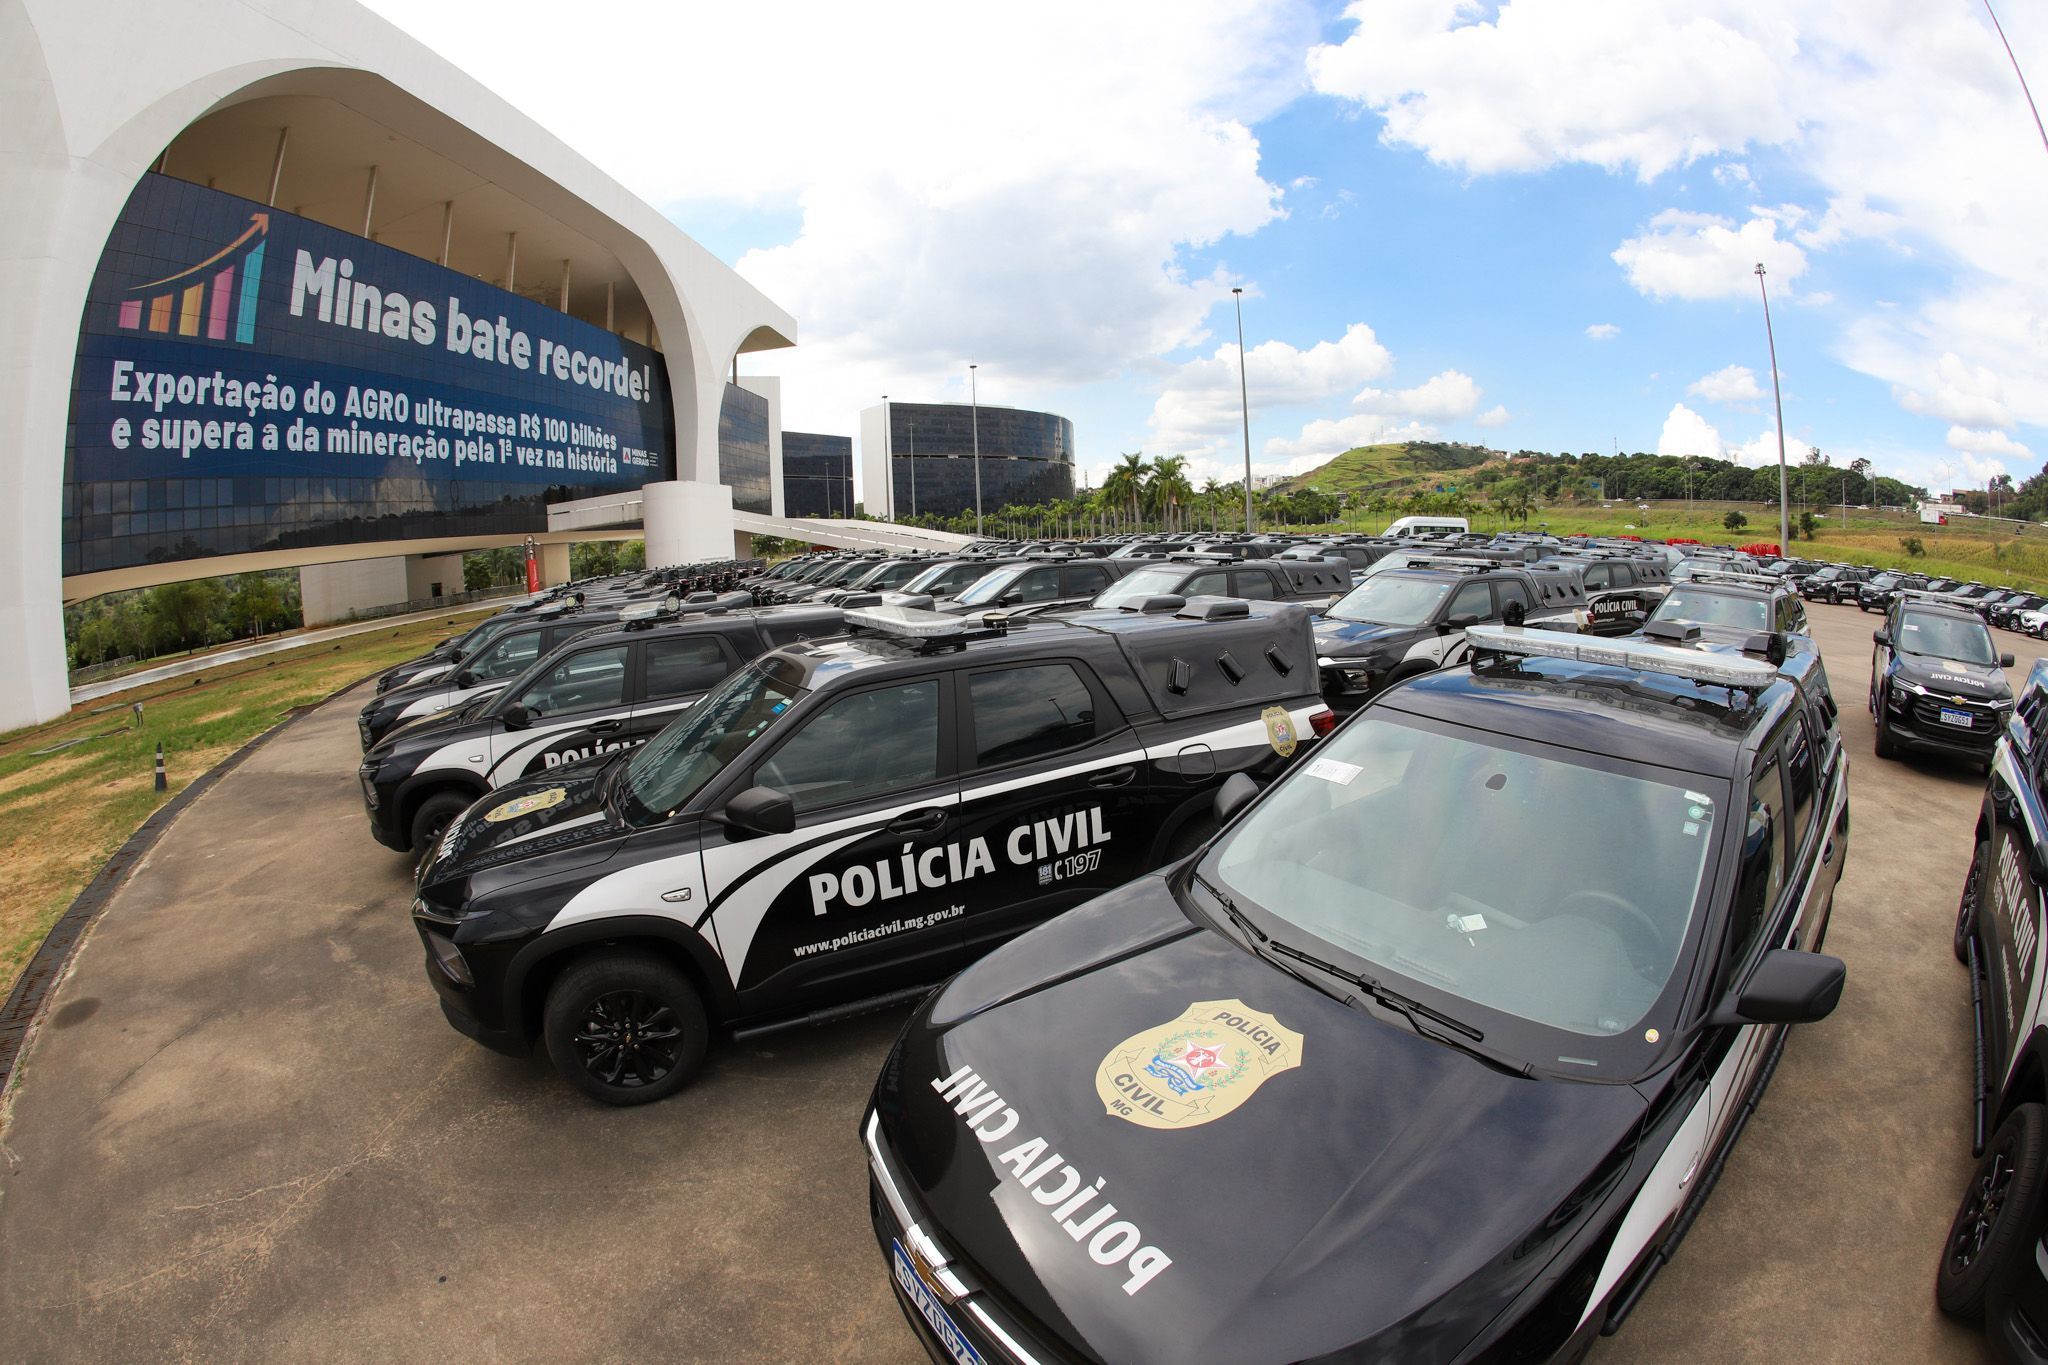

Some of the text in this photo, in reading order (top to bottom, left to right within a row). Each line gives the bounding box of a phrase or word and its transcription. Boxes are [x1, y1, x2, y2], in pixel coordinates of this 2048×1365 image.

[290, 248, 651, 404] Minas bate recorde!
[111, 360, 618, 451] Exportação do AGRO ultrapassa R$ 100 bilhões
[111, 418, 132, 450] e
[141, 417, 254, 459] supera
[262, 423, 279, 451] a
[286, 417, 320, 452] da
[327, 420, 450, 466] mineração
[455, 435, 495, 467] pela
[499, 438, 513, 464] 1ª
[516, 446, 544, 468] vez
[547, 449, 565, 469] na
[567, 446, 618, 475] história
[631, 448, 648, 458] MINAS
[631, 457, 650, 467] GERAIS
[1594, 600, 1638, 614] POLÍCIA CIVIL
[808, 806, 1112, 917] POLÍCIA CIVIL
[1064, 849, 1102, 878] 197
[793, 903, 966, 958] www.policiacivil.mg.gov.br
[1212, 1011, 1282, 1056] POLÍCIA
[1110, 1098, 1133, 1117] MG
[1113, 1073, 1165, 1116] CIVIL
